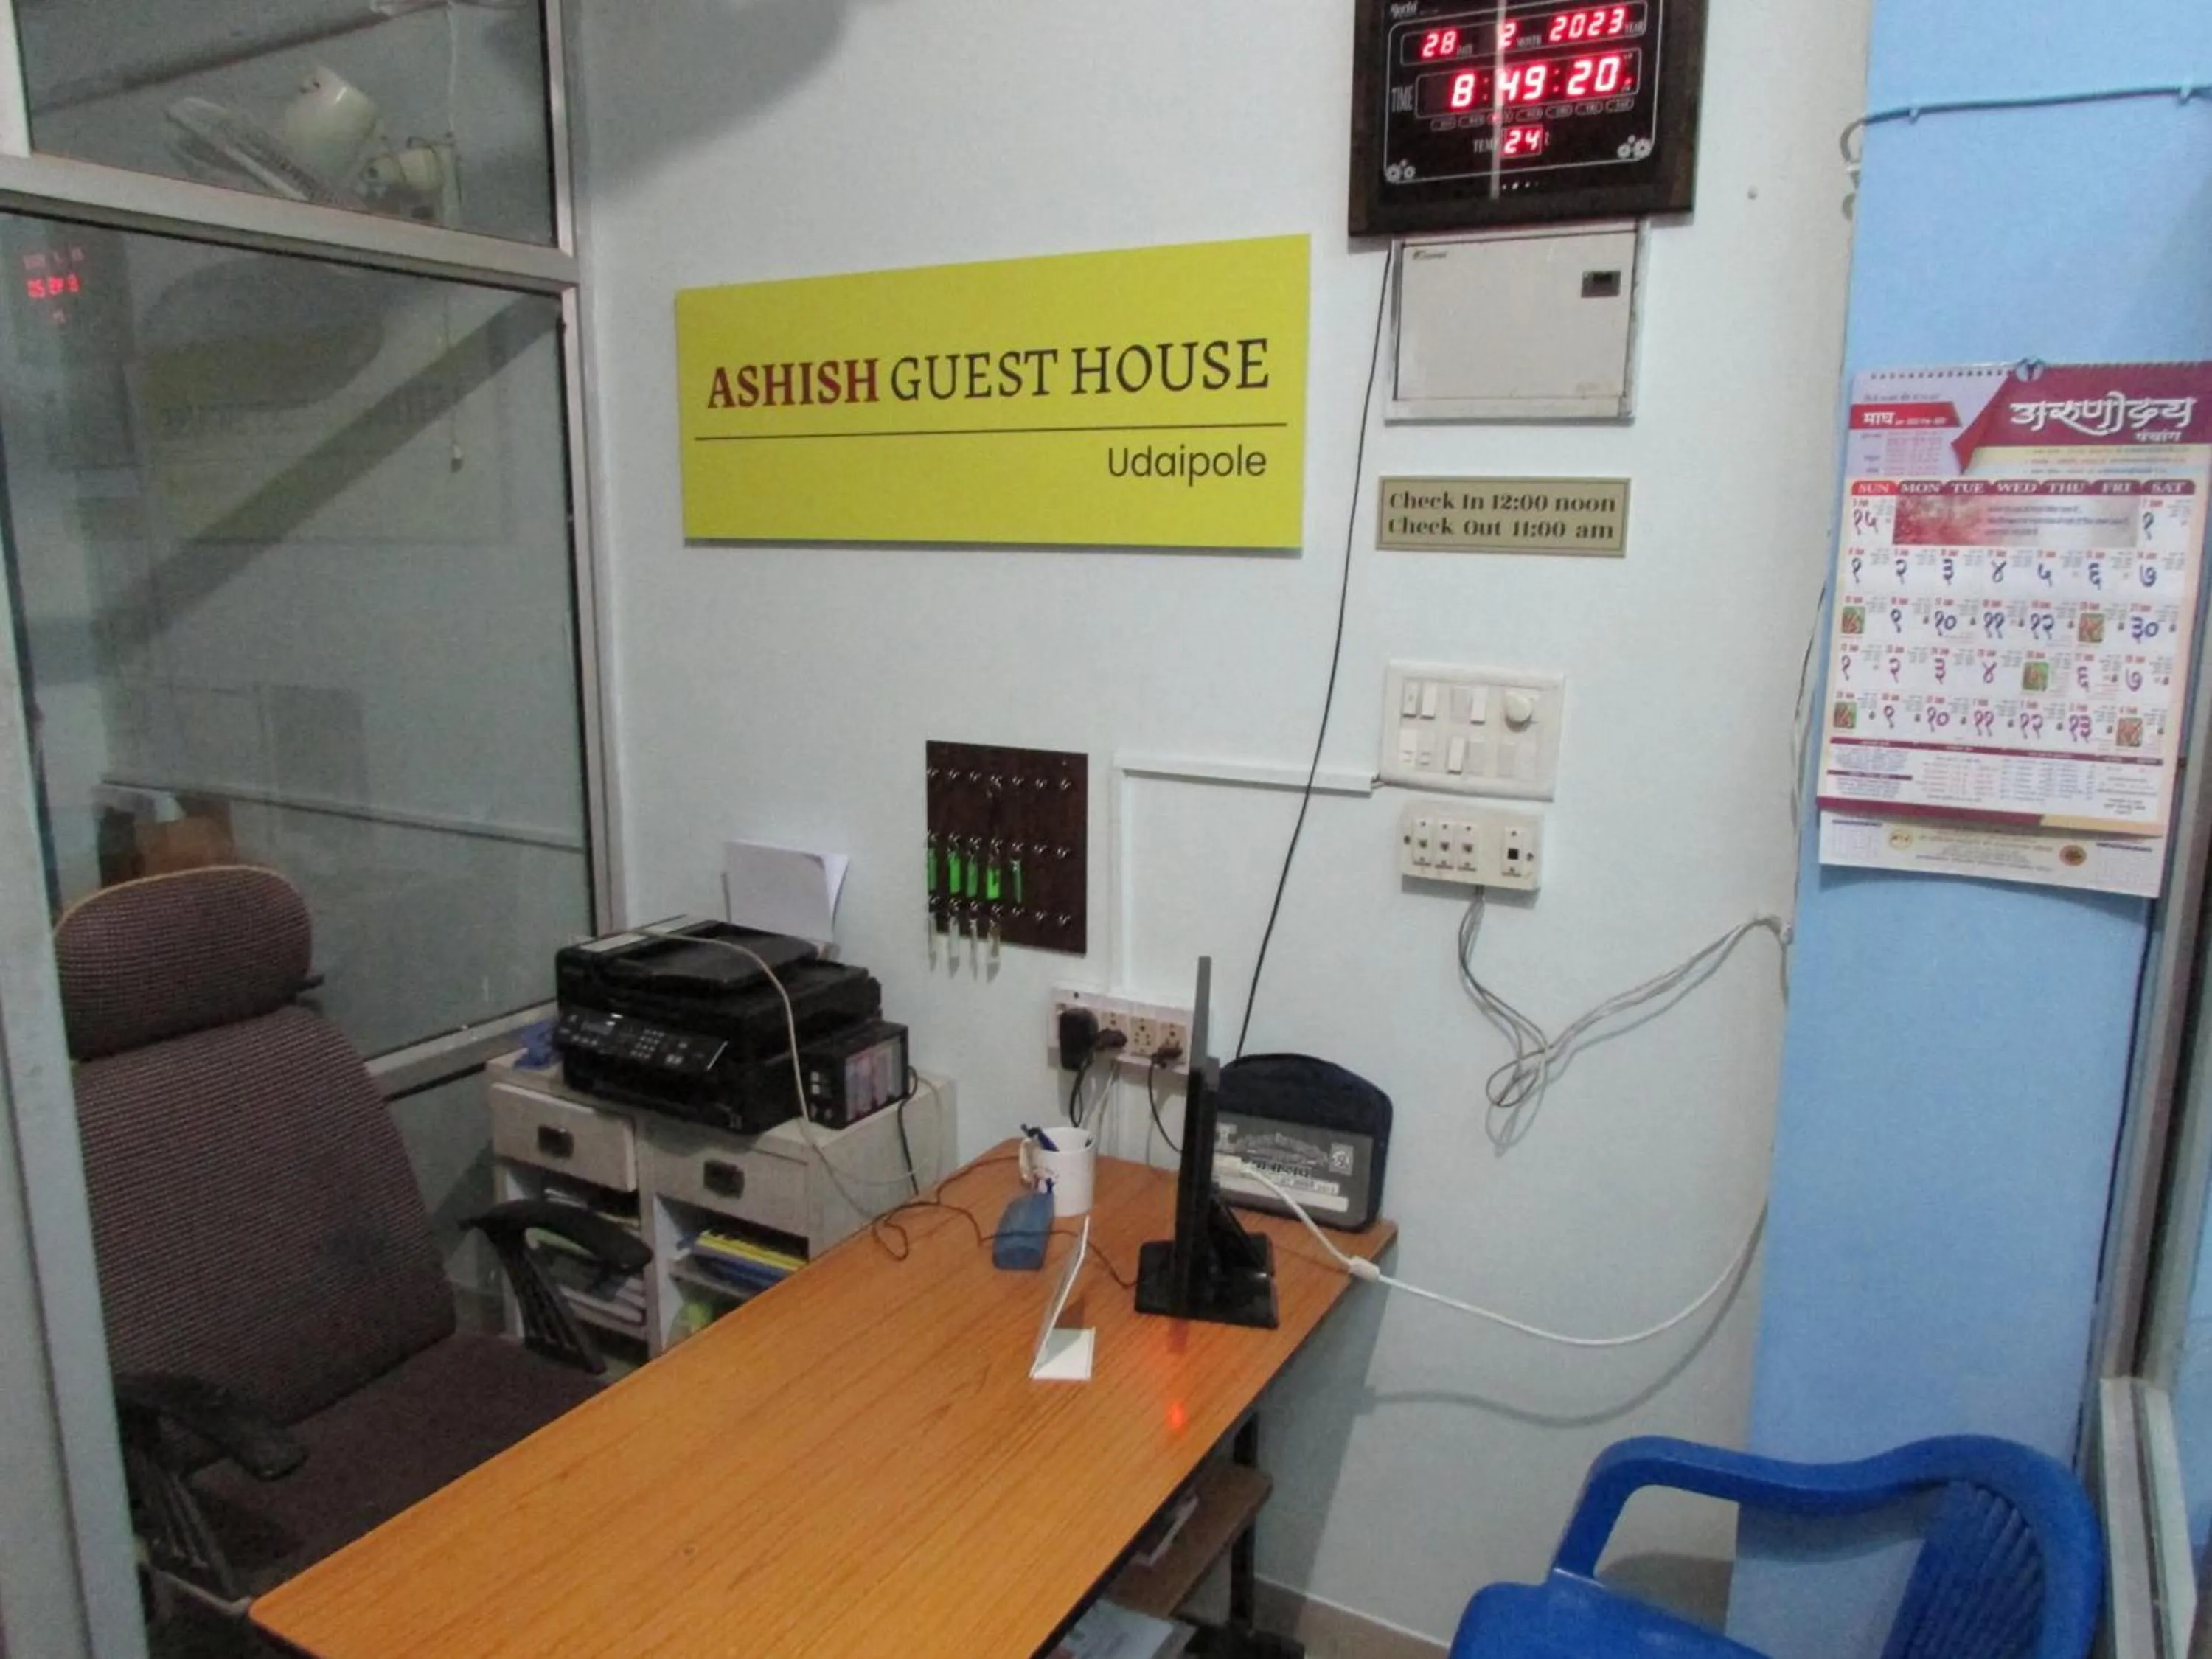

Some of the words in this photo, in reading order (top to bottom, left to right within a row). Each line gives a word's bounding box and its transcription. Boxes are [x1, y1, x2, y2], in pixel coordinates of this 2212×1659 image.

[1422, 30, 1458, 58] 28
[1498, 20, 1517, 49] 2
[1549, 7, 1625, 42] 2023
[1391, 85, 1414, 113] TIME
[1503, 129, 1541, 155] 24
[706, 357, 879, 409] ASHISH
[890, 348, 1060, 402] GUEST
[1071, 337, 1270, 395] HOUSE
[1863, 410, 1896, 425] माघ
[1107, 443, 1267, 487] Udaipole
[1857, 483, 1890, 493] SUN
[1900, 483, 1941, 493] MON
[1951, 483, 1985, 493] TUE
[1996, 483, 2037, 493] WED
[2047, 482, 2085, 493] THU
[2101, 482, 2131, 493] FRI
[2151, 482, 2188, 493] SAT
[1388, 489, 1455, 510] Check
[1462, 492, 1484, 510] In
[1492, 493, 1549, 512] 12:00
[1554, 494, 1616, 513] noon
[1388, 515, 1454, 536] Check
[1463, 518, 1502, 537] Out
[1512, 520, 1566, 539] 11:00
[1575, 522, 1615, 540] am
